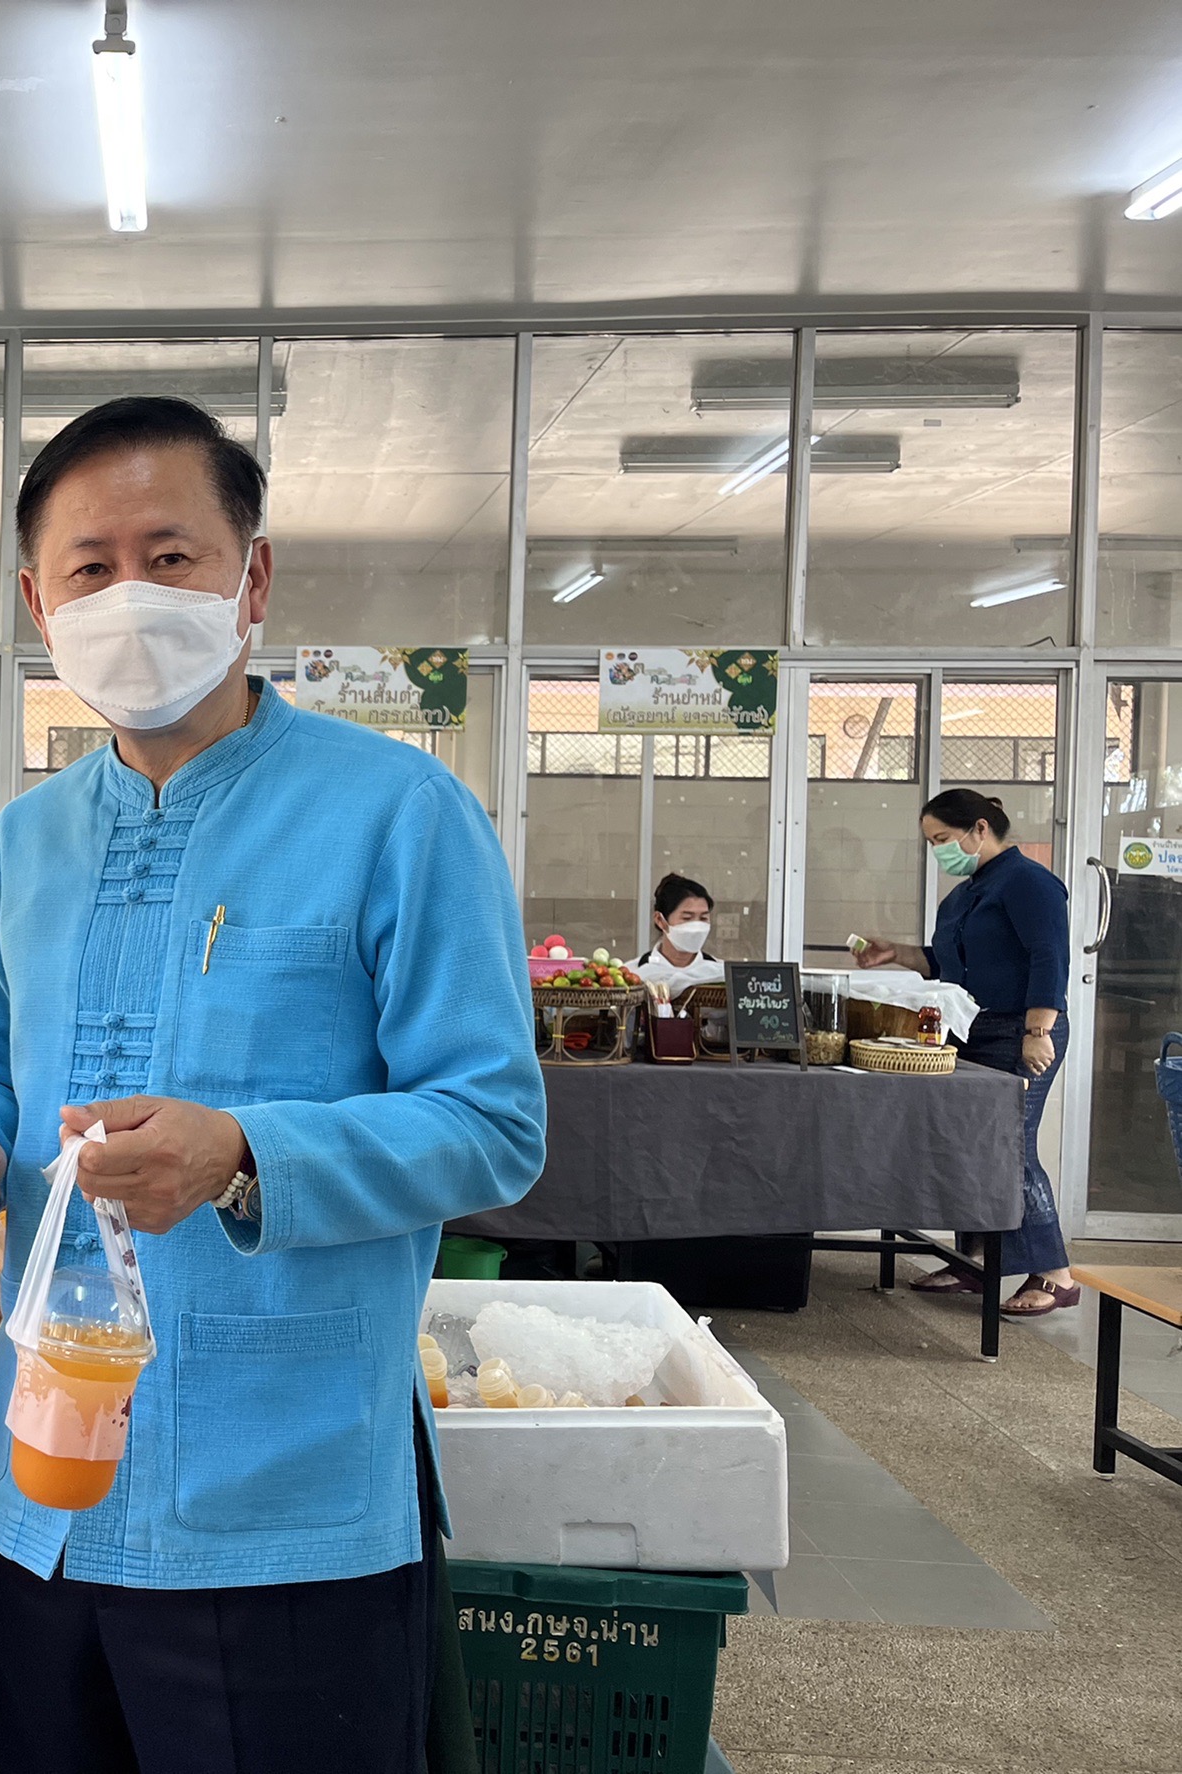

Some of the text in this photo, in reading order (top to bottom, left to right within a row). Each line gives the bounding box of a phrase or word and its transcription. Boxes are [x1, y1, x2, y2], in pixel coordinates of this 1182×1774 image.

[338, 682, 421, 704] ร้านส้มตำ
[651, 682, 723, 706] ร้านยำหมี่
[520, 1637, 599, 1667] 2561
